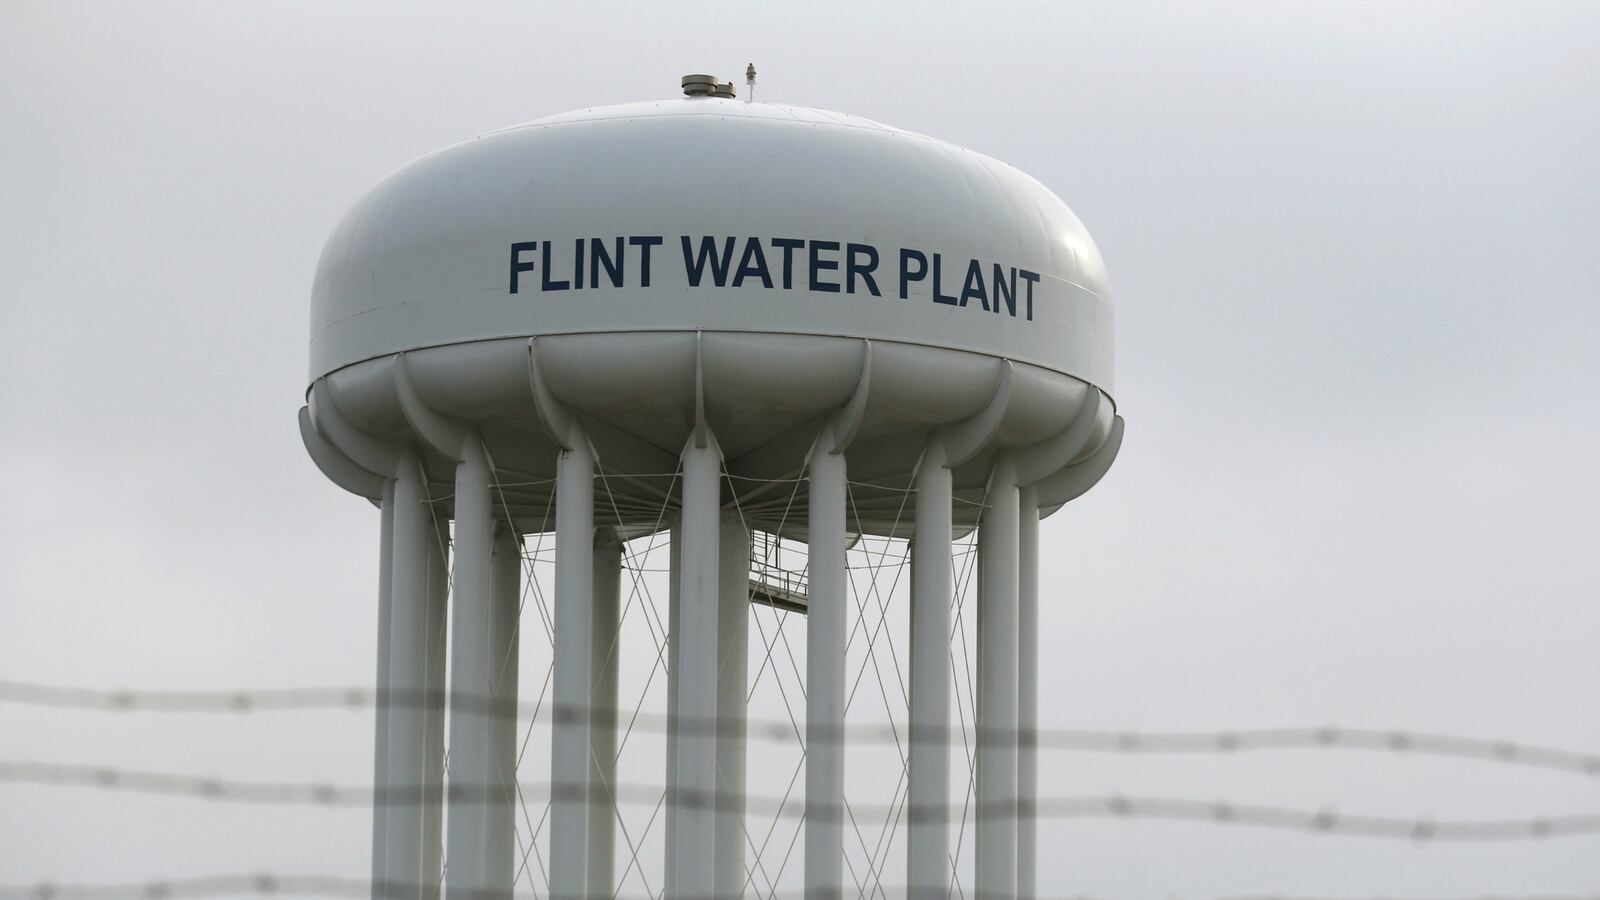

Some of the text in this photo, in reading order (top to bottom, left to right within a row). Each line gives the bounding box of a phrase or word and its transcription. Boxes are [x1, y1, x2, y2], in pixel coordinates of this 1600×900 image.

[509, 235, 1041, 322] FLINT WATER PLANT
